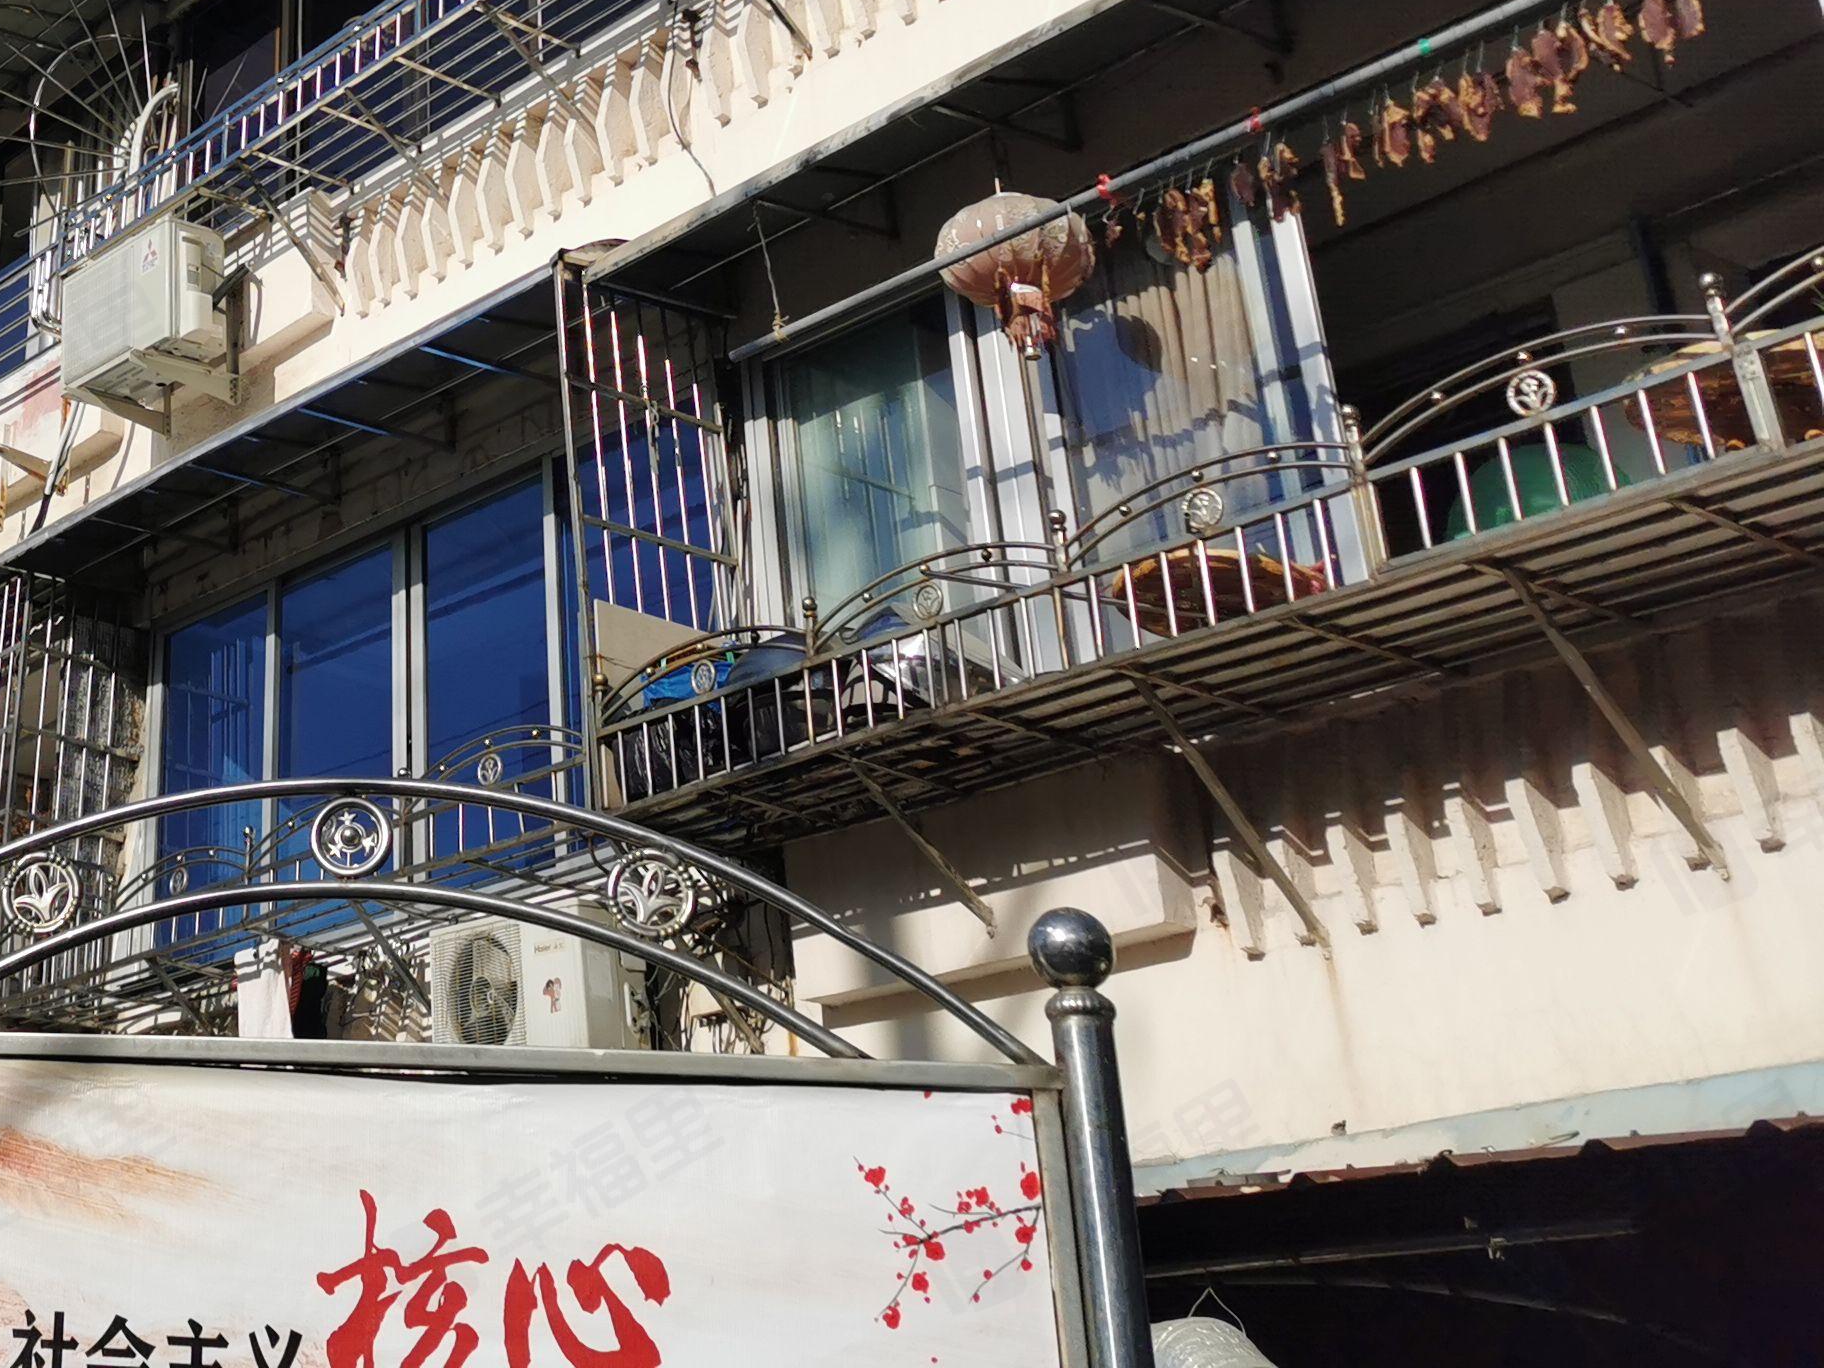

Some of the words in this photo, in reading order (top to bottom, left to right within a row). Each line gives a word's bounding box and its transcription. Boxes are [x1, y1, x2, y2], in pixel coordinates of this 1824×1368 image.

[10, 1309, 304, 1368] 社会主义
[315, 1189, 670, 1368] 核心
